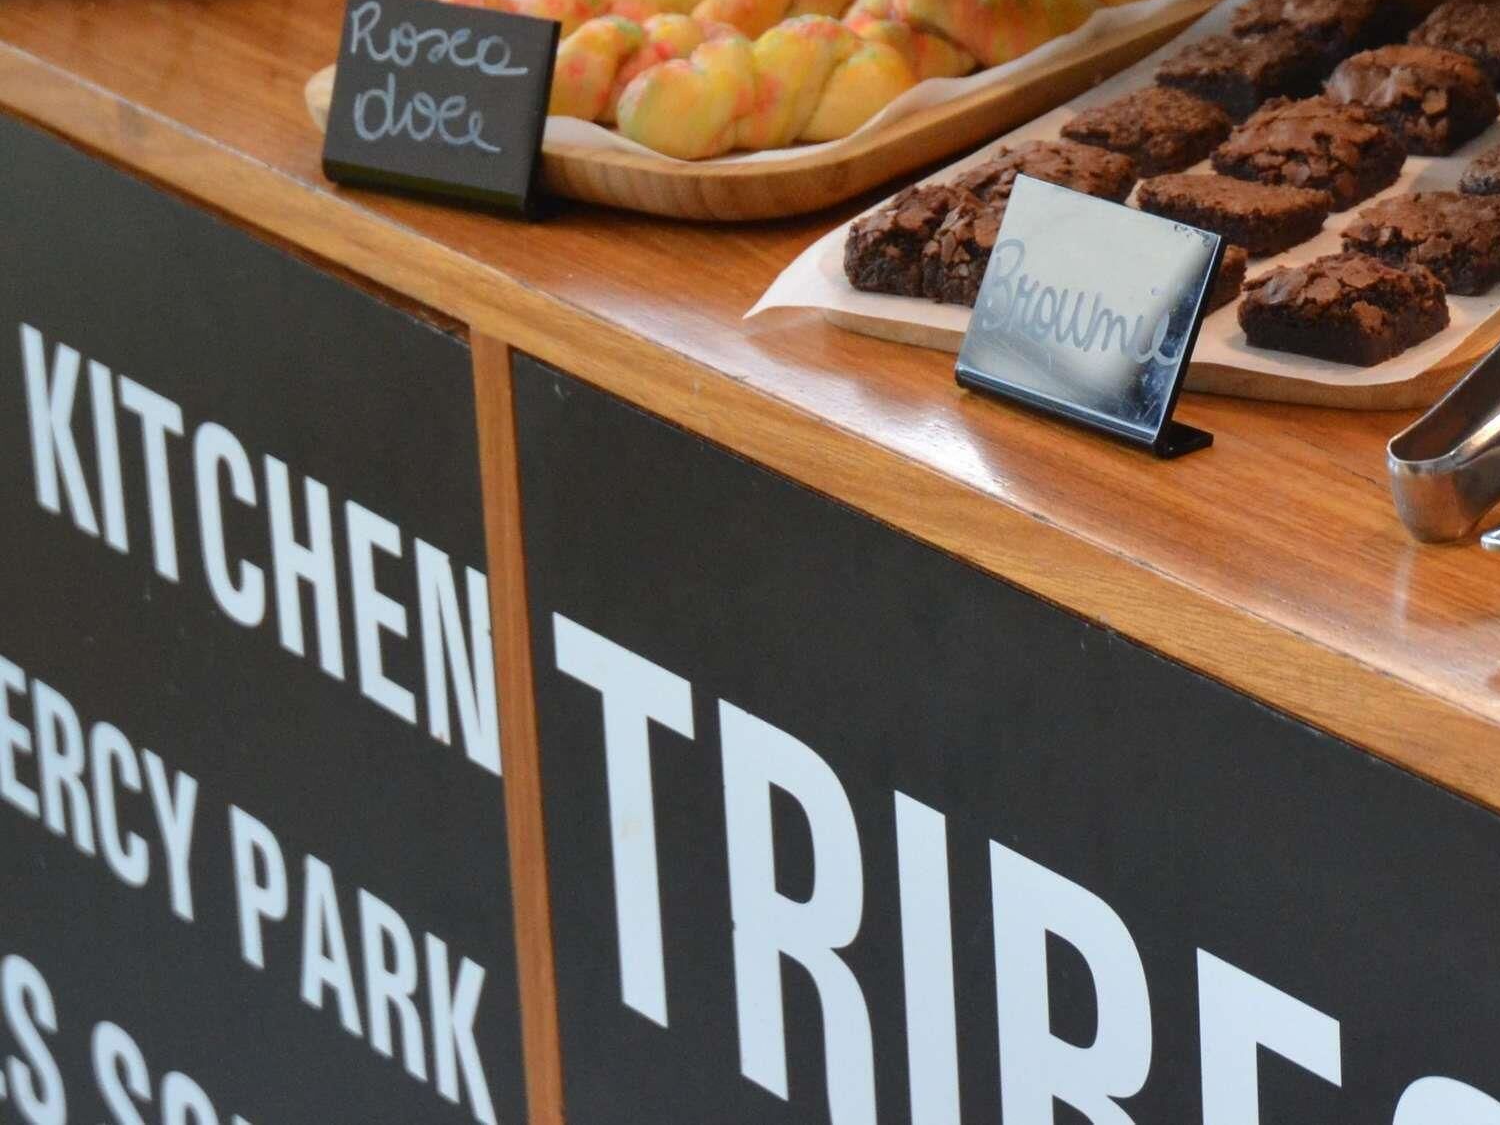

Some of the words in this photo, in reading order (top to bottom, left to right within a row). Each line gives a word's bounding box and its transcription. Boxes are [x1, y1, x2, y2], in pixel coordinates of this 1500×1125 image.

[354, 73, 502, 154] doce
[20, 323, 502, 777] KITCHEN
[0, 654, 198, 923] ERCY
[228, 803, 499, 1125] PARK
